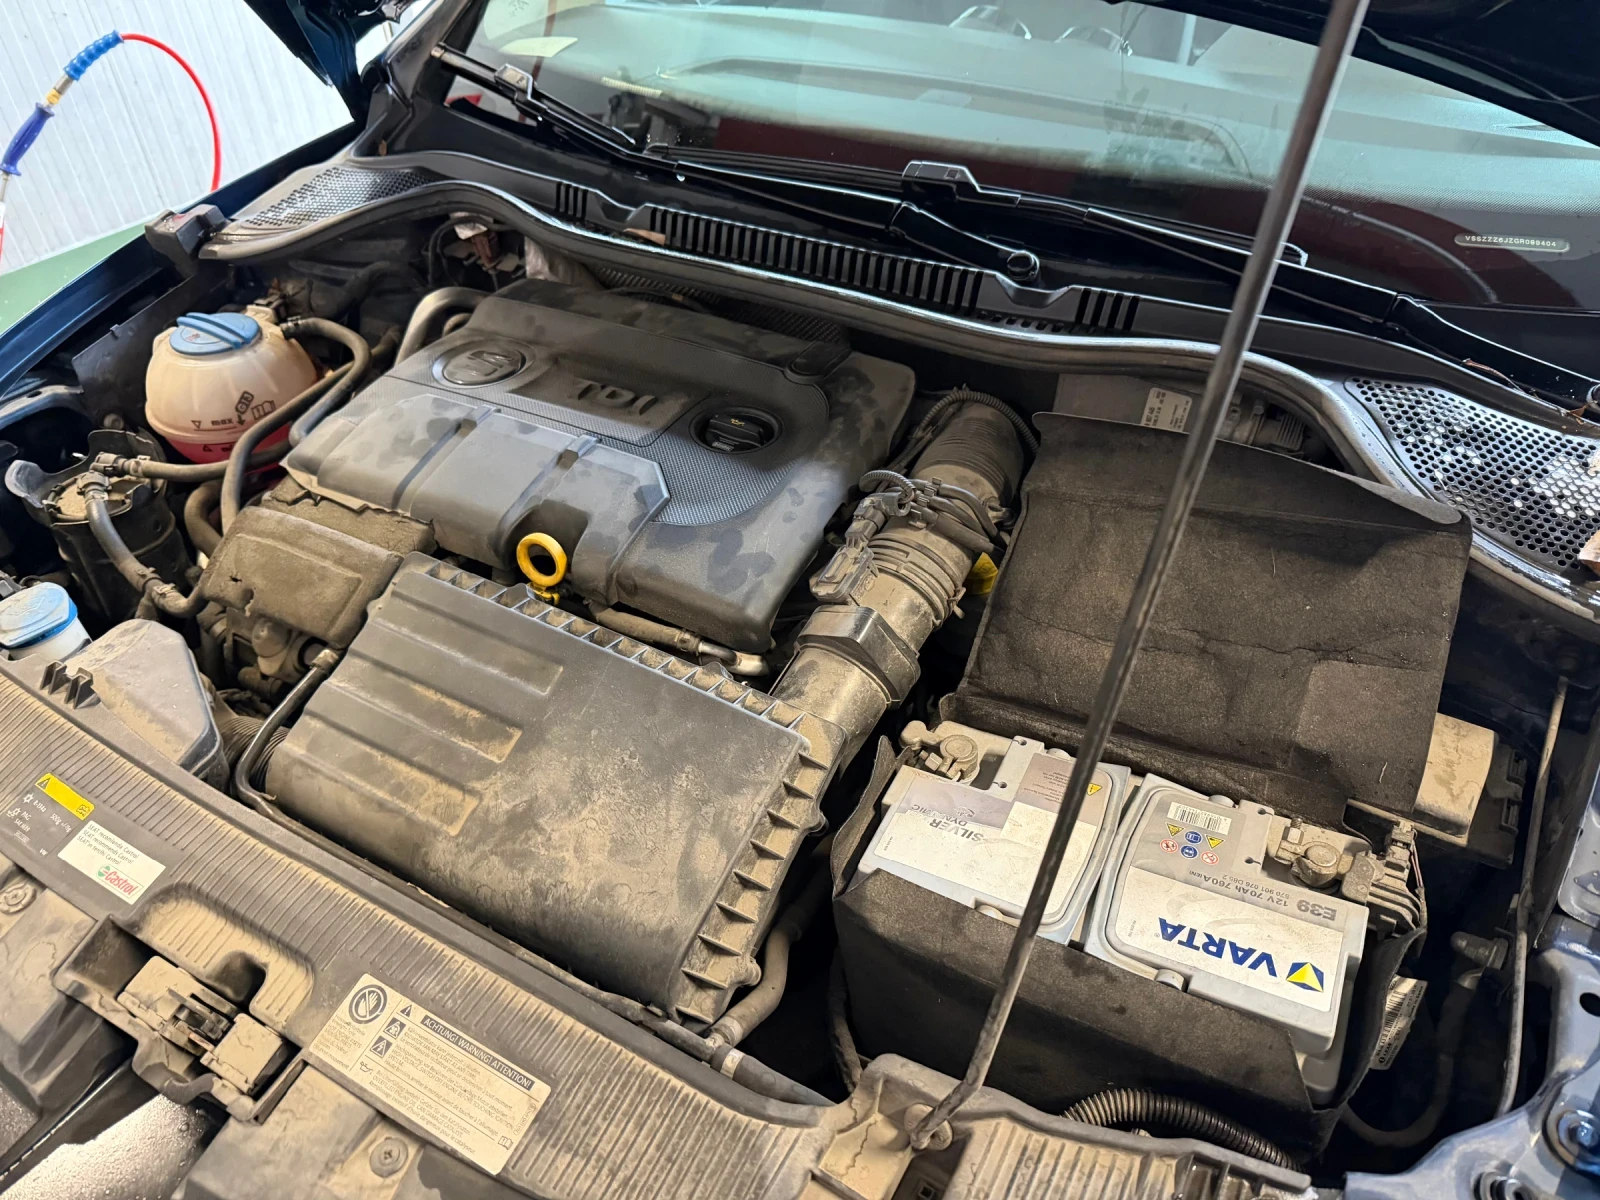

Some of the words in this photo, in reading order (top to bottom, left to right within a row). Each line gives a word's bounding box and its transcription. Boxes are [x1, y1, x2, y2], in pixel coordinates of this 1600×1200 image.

[571, 376, 660, 416] TDI
[211, 418, 233, 426] max
[21, 811, 31, 821] PAG
[87, 824, 99, 833] SEAT
[98, 831, 123, 849] recomienda
[123, 846, 139, 859] Castrol
[929, 818, 984, 842] SILVER
[82, 829, 94, 839] SEAT
[92, 836, 119, 855] recommends
[117, 852, 133, 864] Castrol
[105, 853, 121, 865] Castrol
[105, 870, 139, 896] Castrol
[1260, 886, 1274, 894] 901
[1267, 895, 1288, 906] 12V
[1295, 898, 1337, 920] E39
[1158, 916, 1278, 978] VARTA
[423, 1018, 458, 1042] ACHTUNG!
[457, 1039, 492, 1063] WARNING!
[490, 1059, 531, 1088] ATTENTION!
